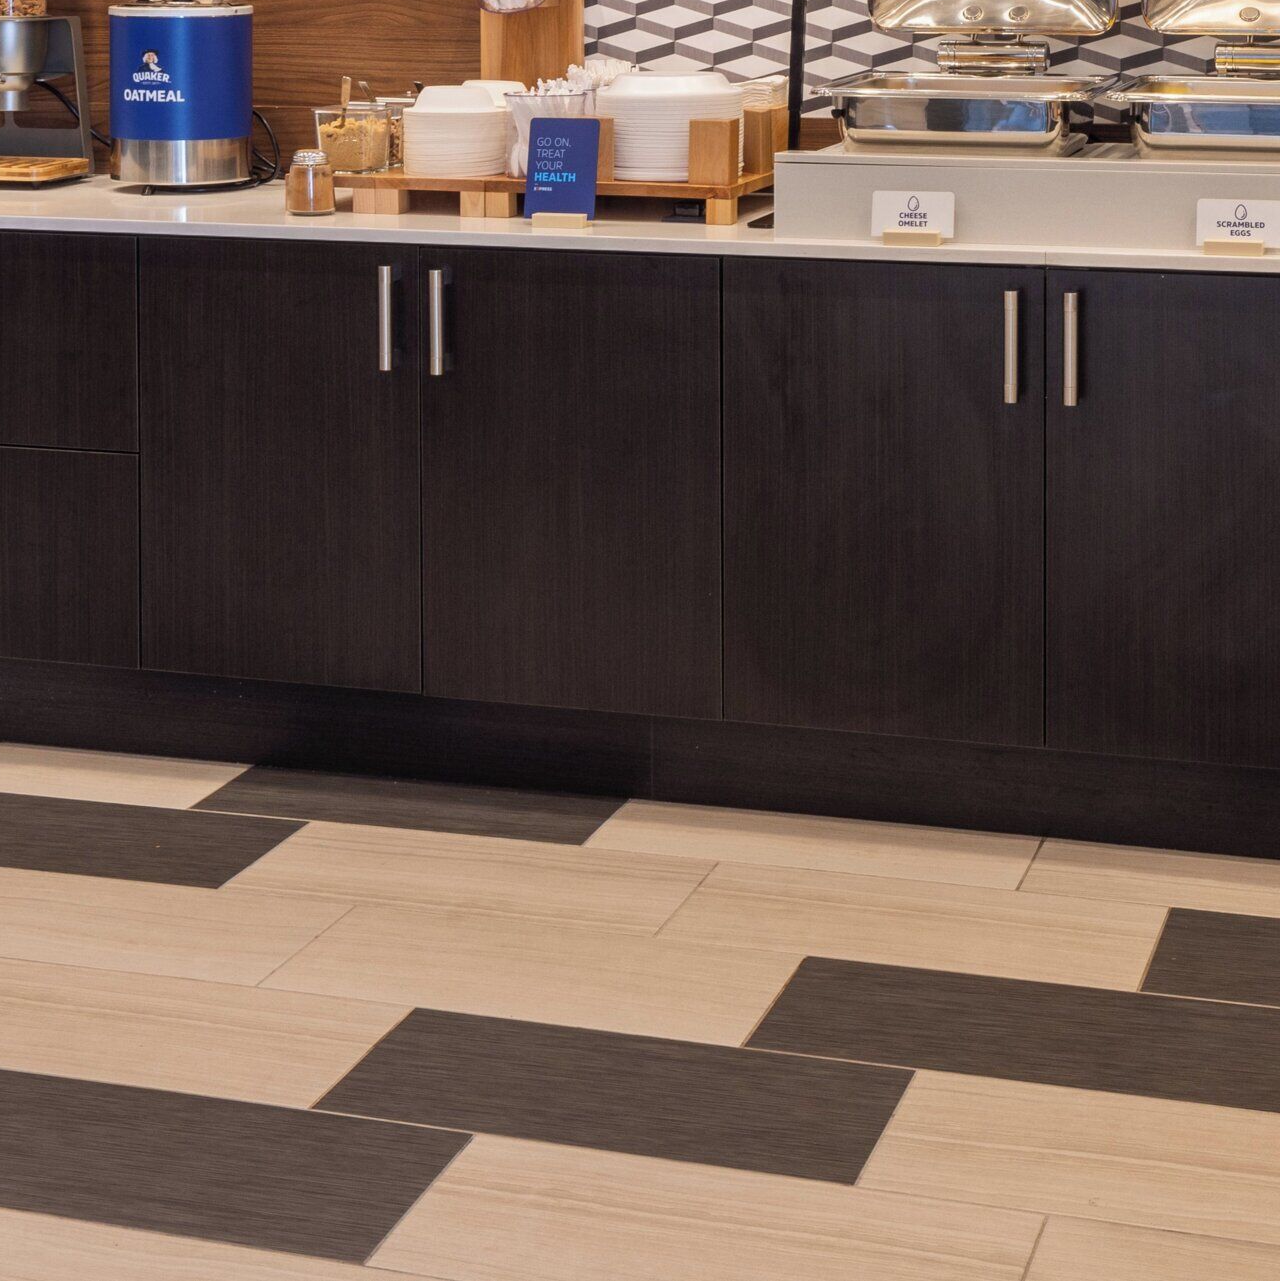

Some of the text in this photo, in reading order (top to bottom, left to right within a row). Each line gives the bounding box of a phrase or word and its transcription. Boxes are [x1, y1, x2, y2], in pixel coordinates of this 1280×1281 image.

[132, 71, 170, 83] QUAKER
[123, 88, 186, 103] OATMEAL
[536, 137, 552, 147] GO
[536, 149, 566, 159] TREAT
[536, 160, 563, 170] YOUR
[534, 172, 576, 182] HEALTH
[1216, 221, 1265, 229] SCRAMBLED
[1230, 229, 1251, 237] EGGS
